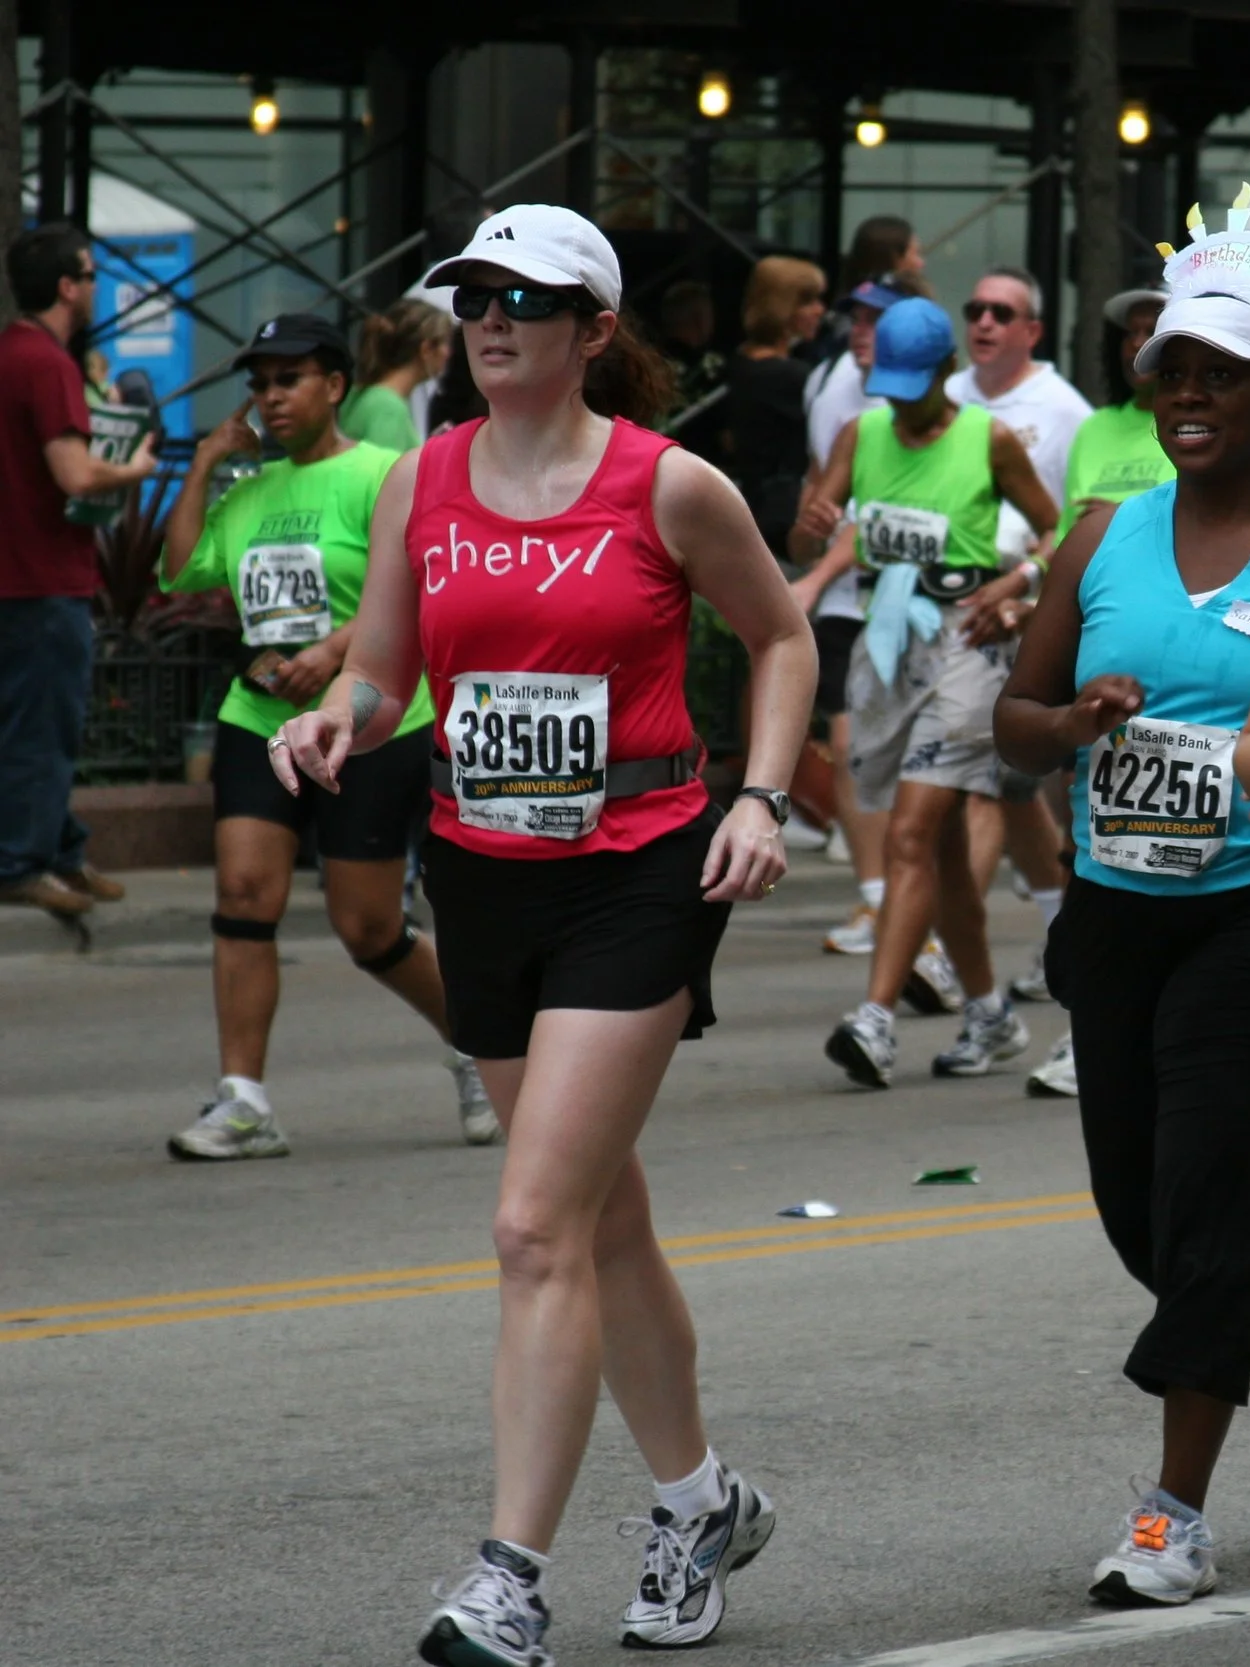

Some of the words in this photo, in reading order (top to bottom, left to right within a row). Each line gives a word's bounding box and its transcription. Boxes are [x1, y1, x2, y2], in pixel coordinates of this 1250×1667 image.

[244, 567, 320, 606] 46729
[495, 685, 539, 700] LaSalle
[544, 686, 580, 701] Bank
[456, 710, 595, 775] 38509
[1132, 728, 1174, 746] LaSalle
[1178, 734, 1212, 751] Bank
[501, 778, 594, 794] ANNIVERSARY
[1092, 750, 1222, 819] 42256
[1103, 819, 1124, 832] 30th
[1127, 821, 1217, 835] ANNIVERSARY
